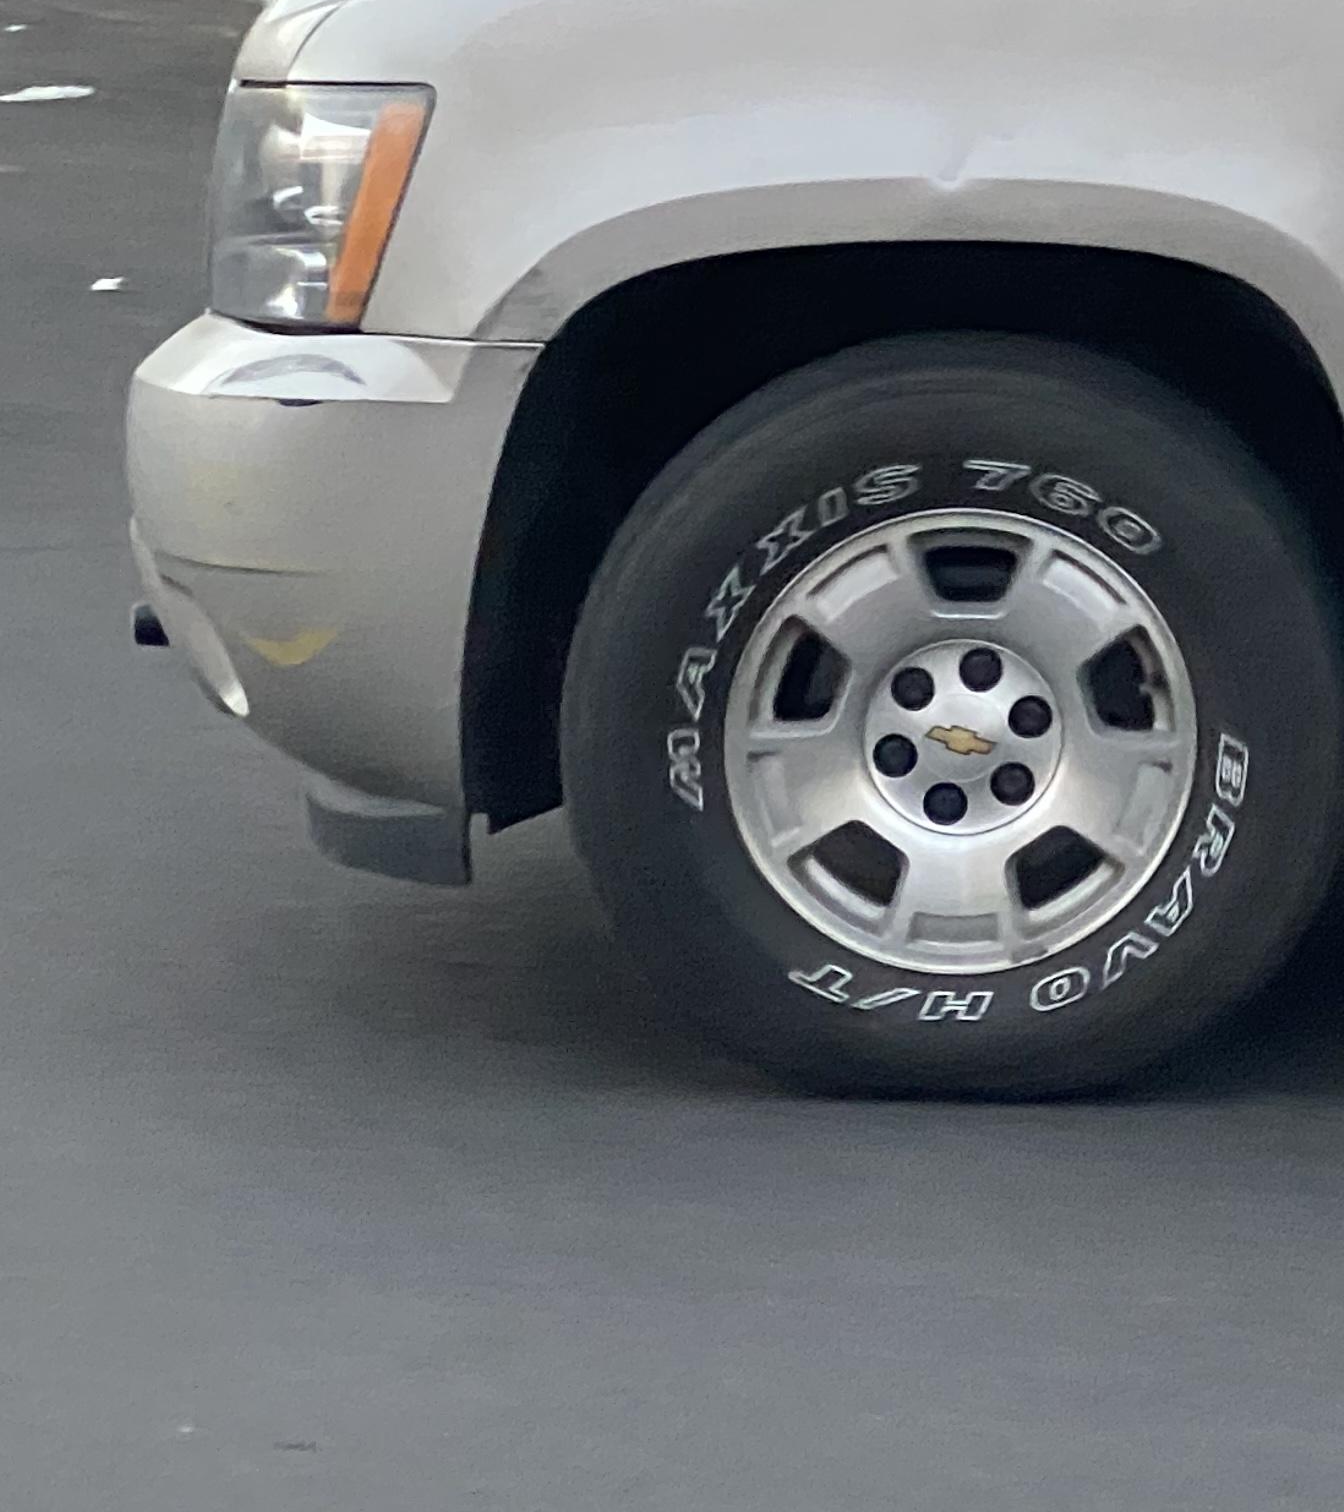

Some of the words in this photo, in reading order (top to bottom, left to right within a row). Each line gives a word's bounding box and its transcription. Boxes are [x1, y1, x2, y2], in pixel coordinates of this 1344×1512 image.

[665, 461, 921, 814] MAXXIS
[962, 458, 1164, 557] 760
[786, 958, 995, 1023] H/T
[1027, 730, 1251, 1013] BRAVO
